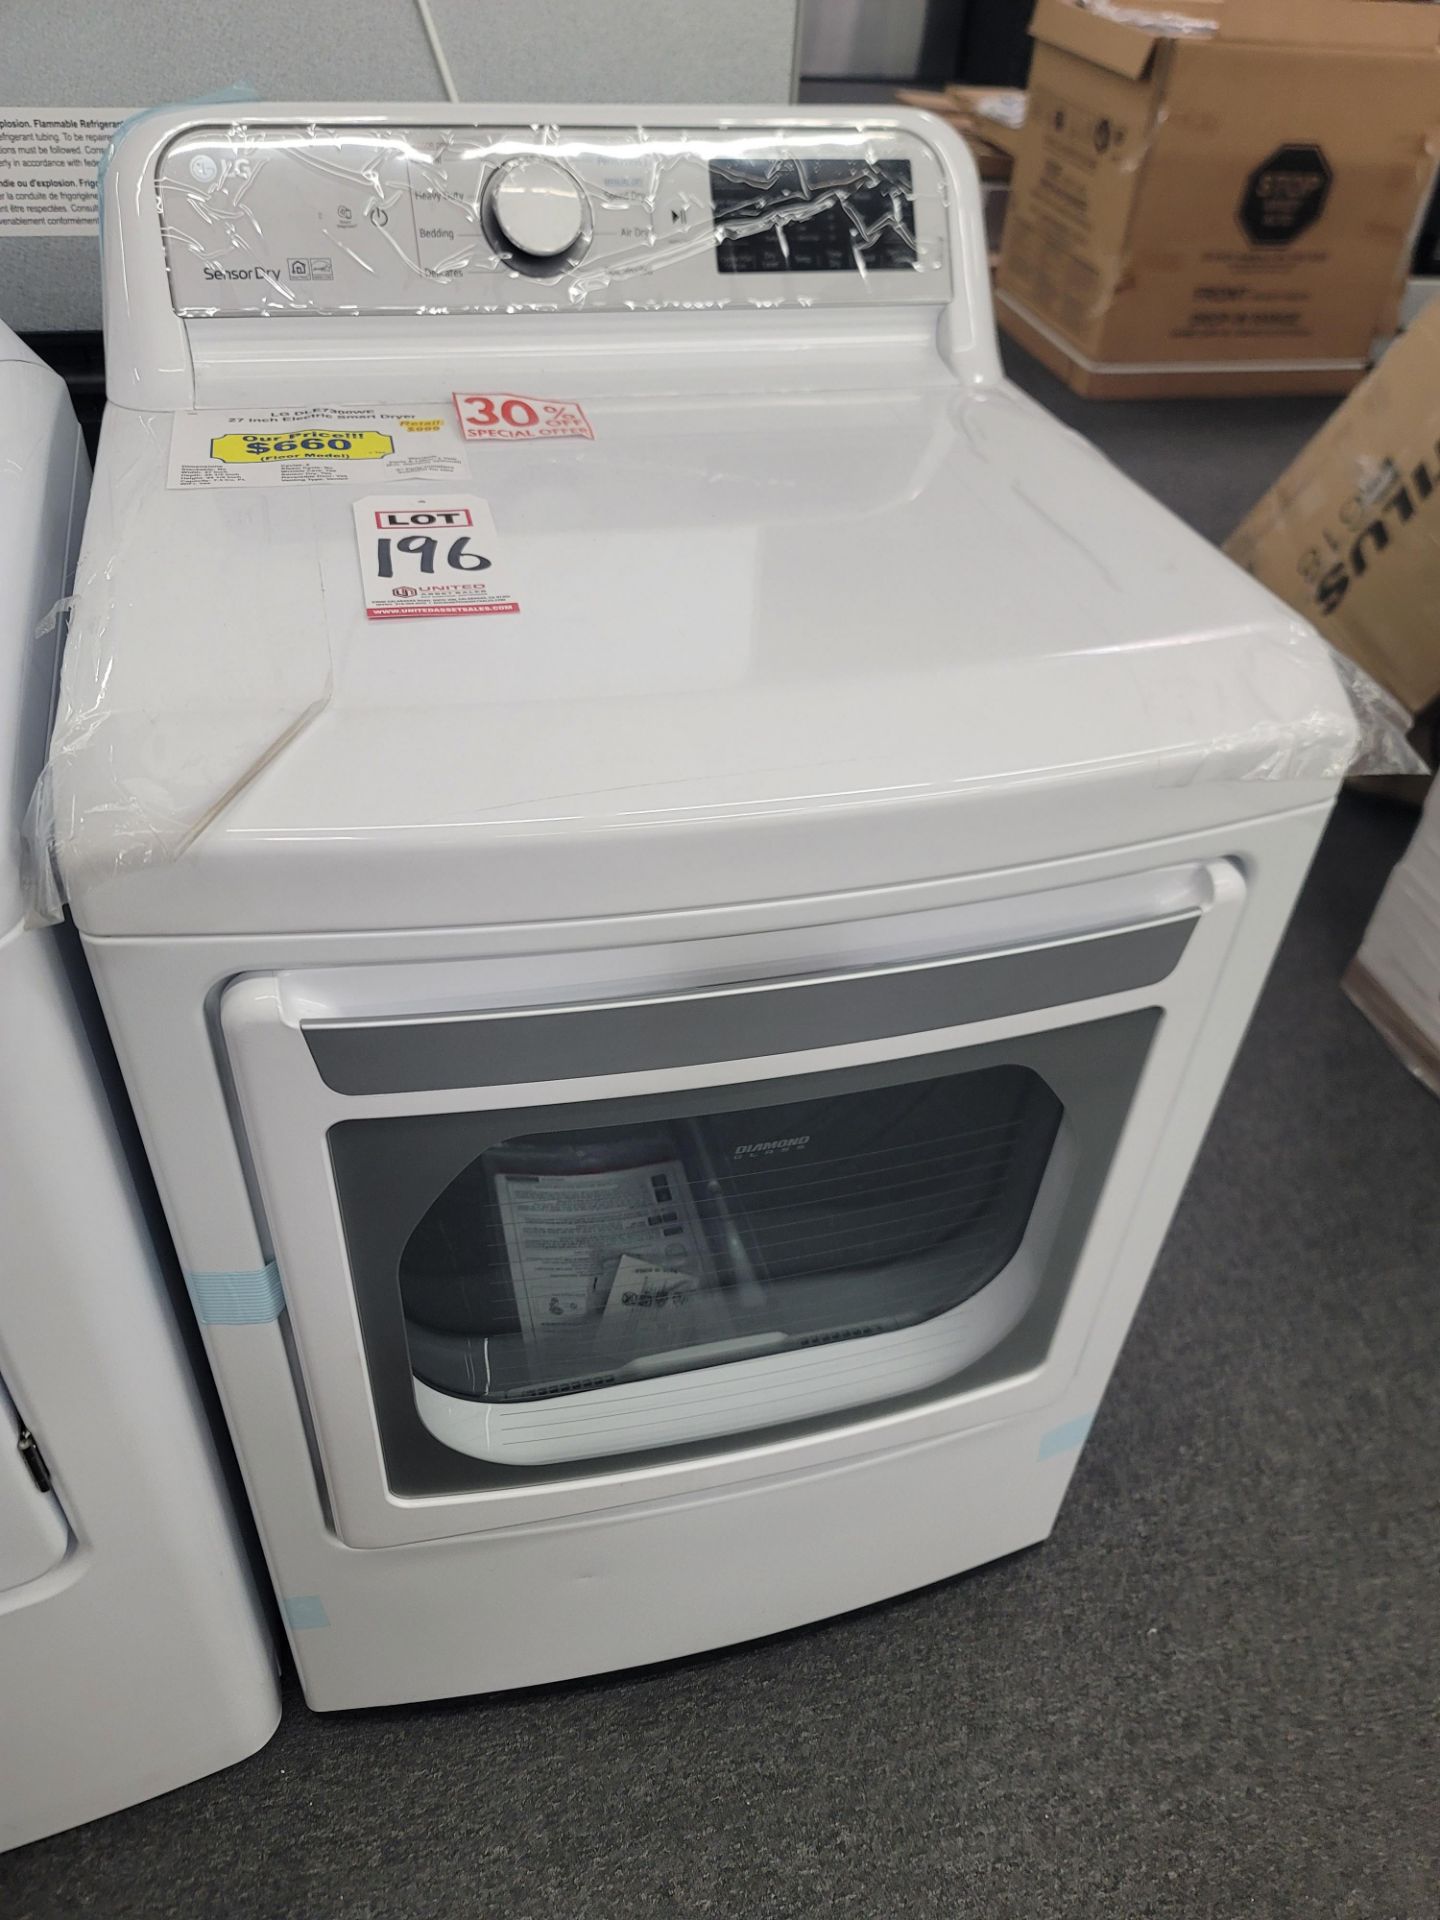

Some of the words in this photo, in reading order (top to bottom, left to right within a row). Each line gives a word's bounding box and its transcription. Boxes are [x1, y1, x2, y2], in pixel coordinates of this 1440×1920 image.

[34, 119, 78, 129] Flammable
[62, 132, 72, 141] To
[74, 132, 84, 141] be
[18, 145, 37, 154] must
[39, 145, 48, 154] be
[13, 159, 20, 167] in
[22, 159, 65, 167] accordance
[68, 159, 83, 167] with
[16, 191, 47, 200] conduite
[49, 191, 59, 200] de
[419, 228, 455, 240] Bedding
[463, 396, 540, 428] 30
[380, 414, 416, 422] Dryer
[545, 419, 581, 428] OFF
[467, 429, 534, 438] SPECIAL
[538, 427, 589, 437] OFFER
[242, 435, 283, 443] Our
[246, 438, 353, 456] $660
[260, 453, 301, 463] (Floor
[304, 453, 350, 461] Model)
[388, 513, 461, 526] LOT
[377, 535, 493, 579] 196
[418, 583, 487, 592] UNITED
[735, 1135, 810, 1155] DIAMOND
